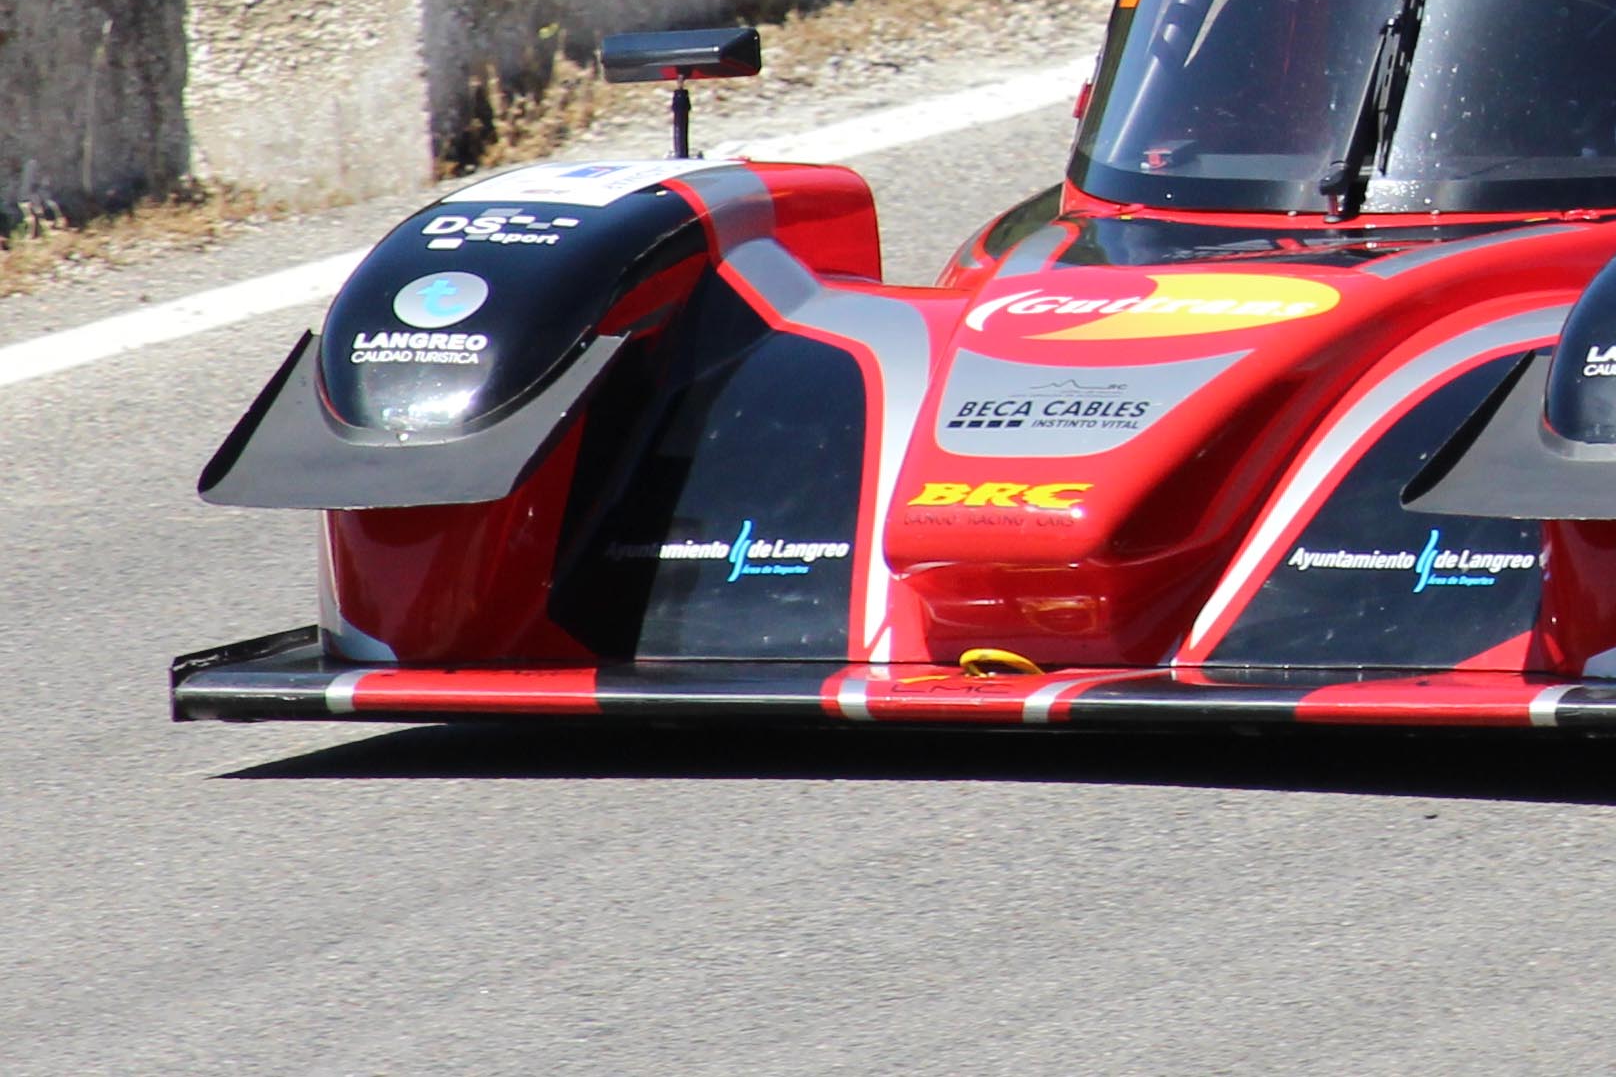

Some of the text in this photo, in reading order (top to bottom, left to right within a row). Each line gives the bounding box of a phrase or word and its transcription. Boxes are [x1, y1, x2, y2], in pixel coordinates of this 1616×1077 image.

[421, 216, 504, 235] DS
[489, 230, 559, 247] sport
[353, 332, 488, 351] LANGREO
[351, 350, 412, 364] CALIDAD
[956, 400, 1151, 418] BECA CABLES
[1032, 419, 1139, 431] INSTINTO VITAL
[908, 481, 1095, 508] BRC
[746, 539, 772, 558] de
[773, 539, 850, 563] Langreo
[1287, 546, 1535, 571] Ayuntamiento de Langreo
